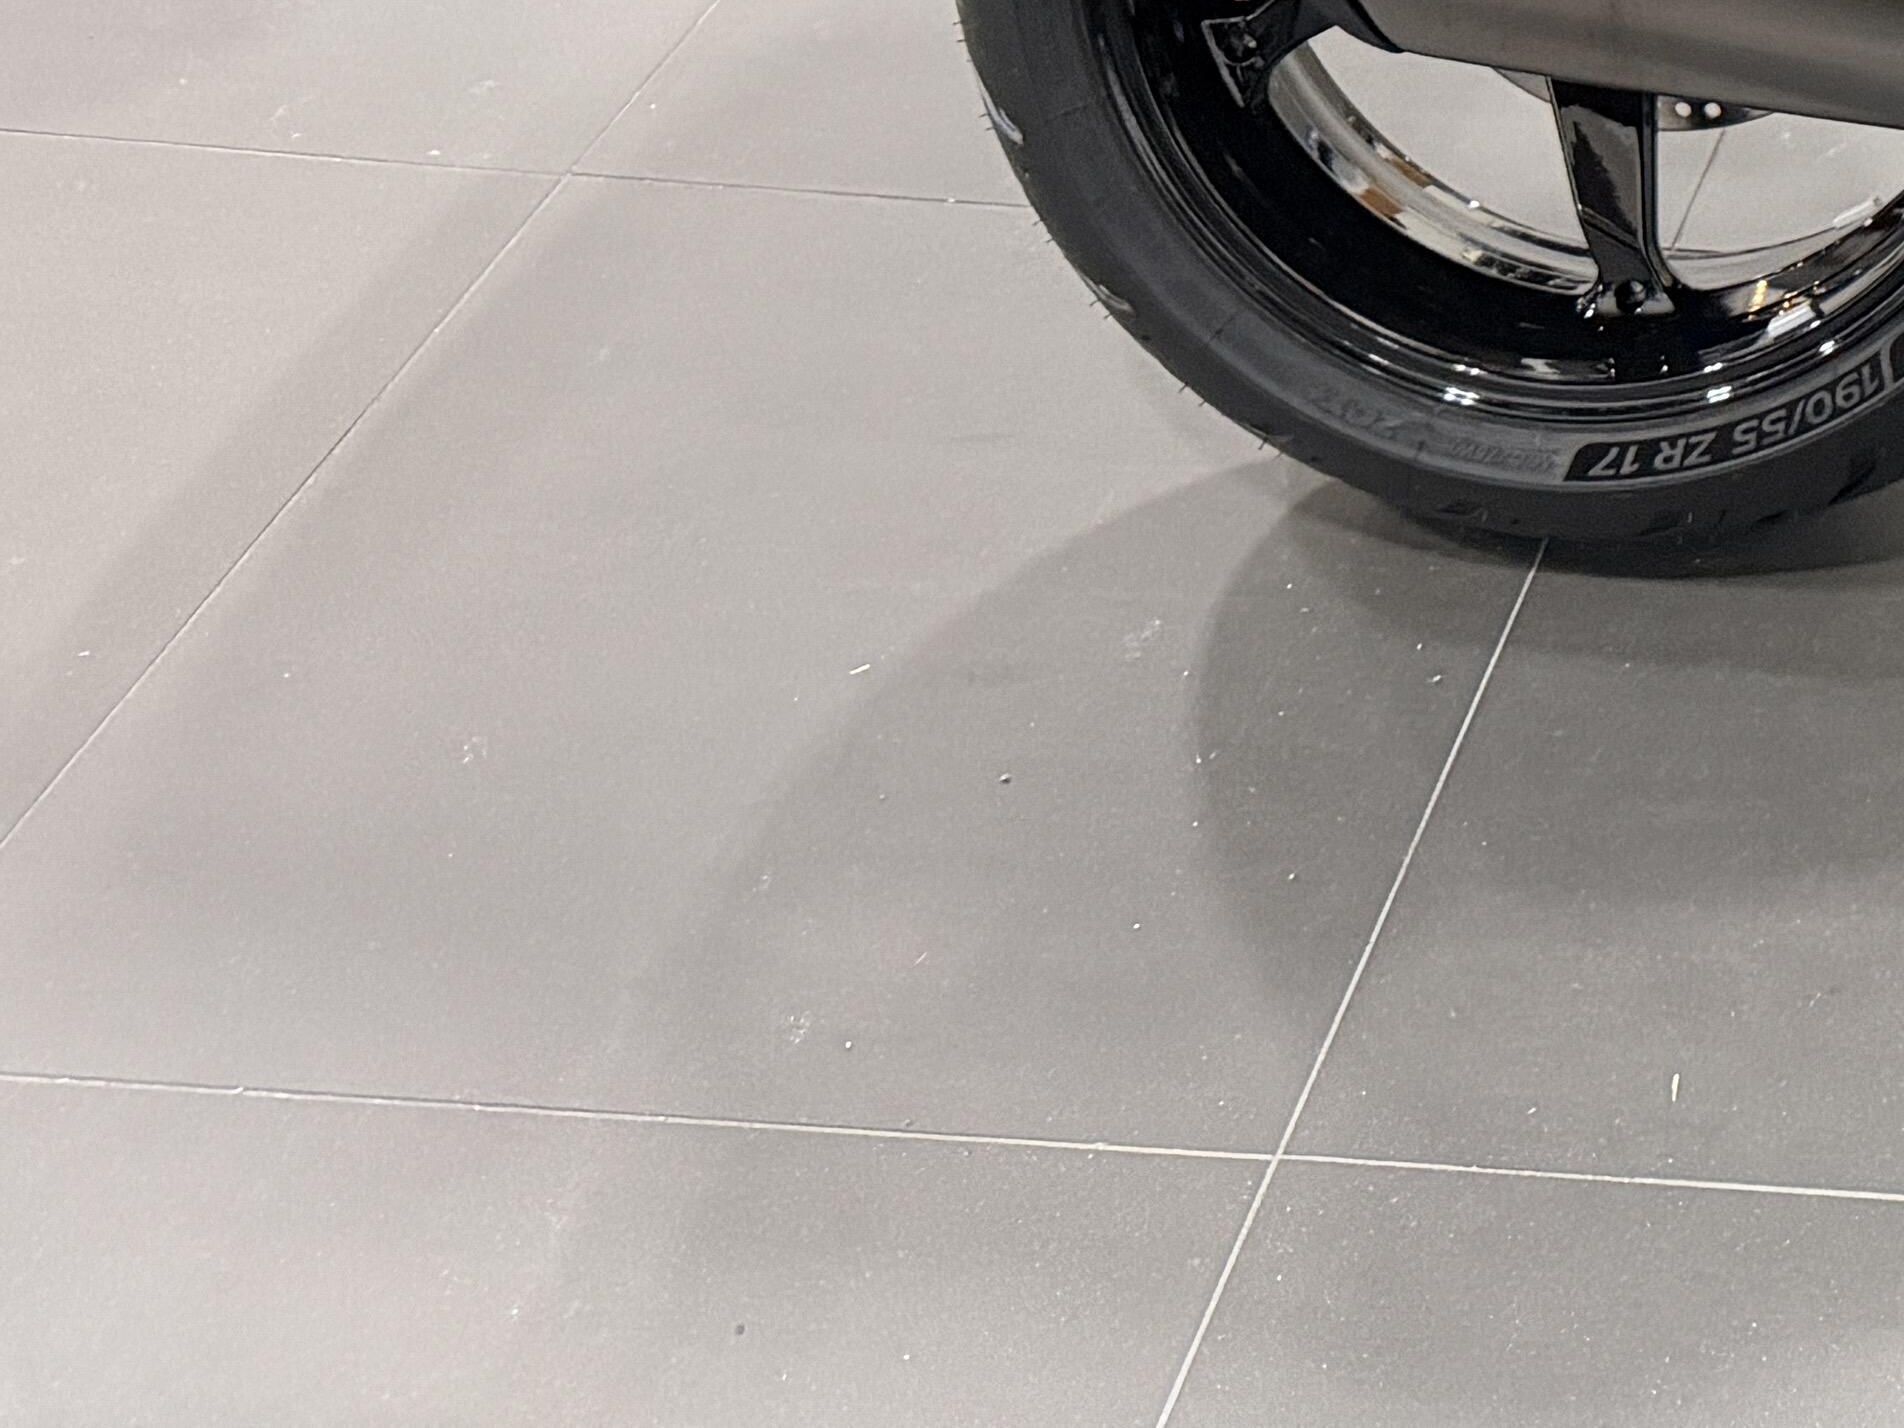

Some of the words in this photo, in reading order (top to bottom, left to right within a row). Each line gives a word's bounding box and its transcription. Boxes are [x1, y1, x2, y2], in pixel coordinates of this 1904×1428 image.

[1732, 363, 1885, 448] 190/55
[1588, 444, 1641, 476] 17
[1654, 437, 1711, 467] ZR
